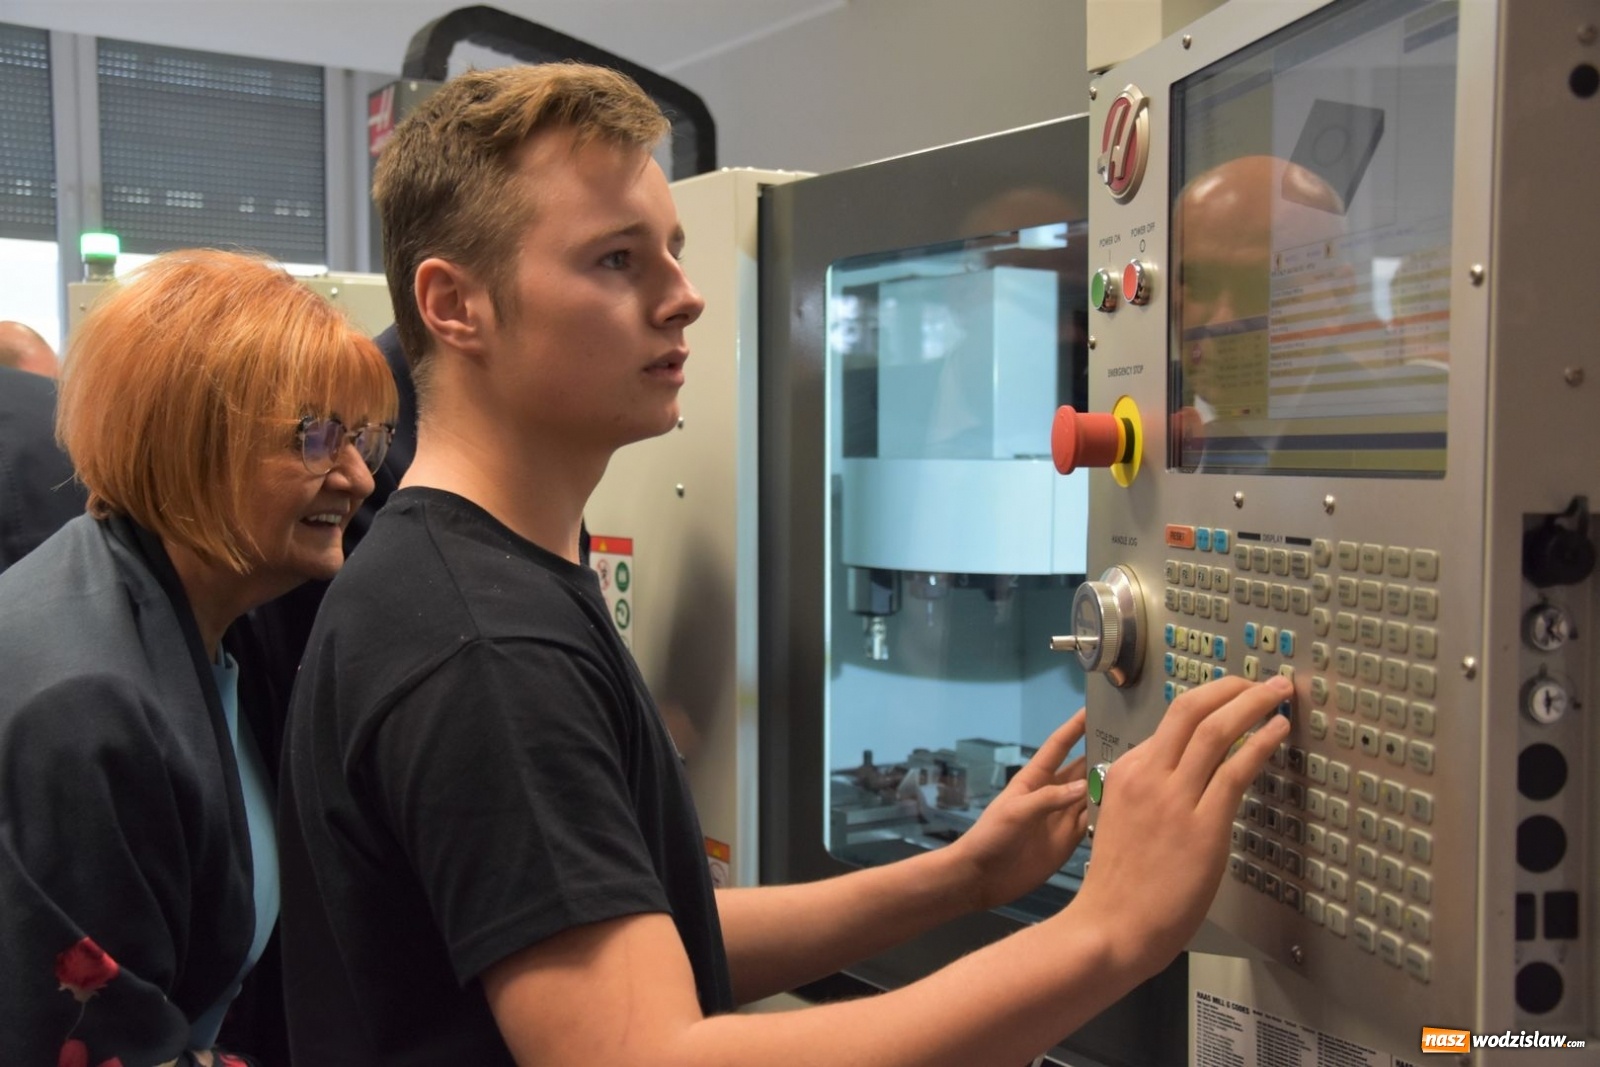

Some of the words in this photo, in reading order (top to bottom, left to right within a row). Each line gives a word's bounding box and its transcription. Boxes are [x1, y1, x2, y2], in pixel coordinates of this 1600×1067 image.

[1131, 225, 1146, 237] POWER
[1147, 222, 1155, 233] OFF
[1099, 236, 1113, 247] POWER
[1114, 234, 1121, 244] ON
[1107, 366, 1132, 378] EMERGENCY
[1133, 364, 1144, 375] STOP
[1111, 535, 1128, 545] HANDLE
[1129, 537, 1138, 547] JOG
[1169, 531, 1185, 541] RESET
[1263, 533, 1283, 543] DISPLAY
[1212, 996, 1225, 1007] MILL
[1231, 1002, 1250, 1015] CODES
